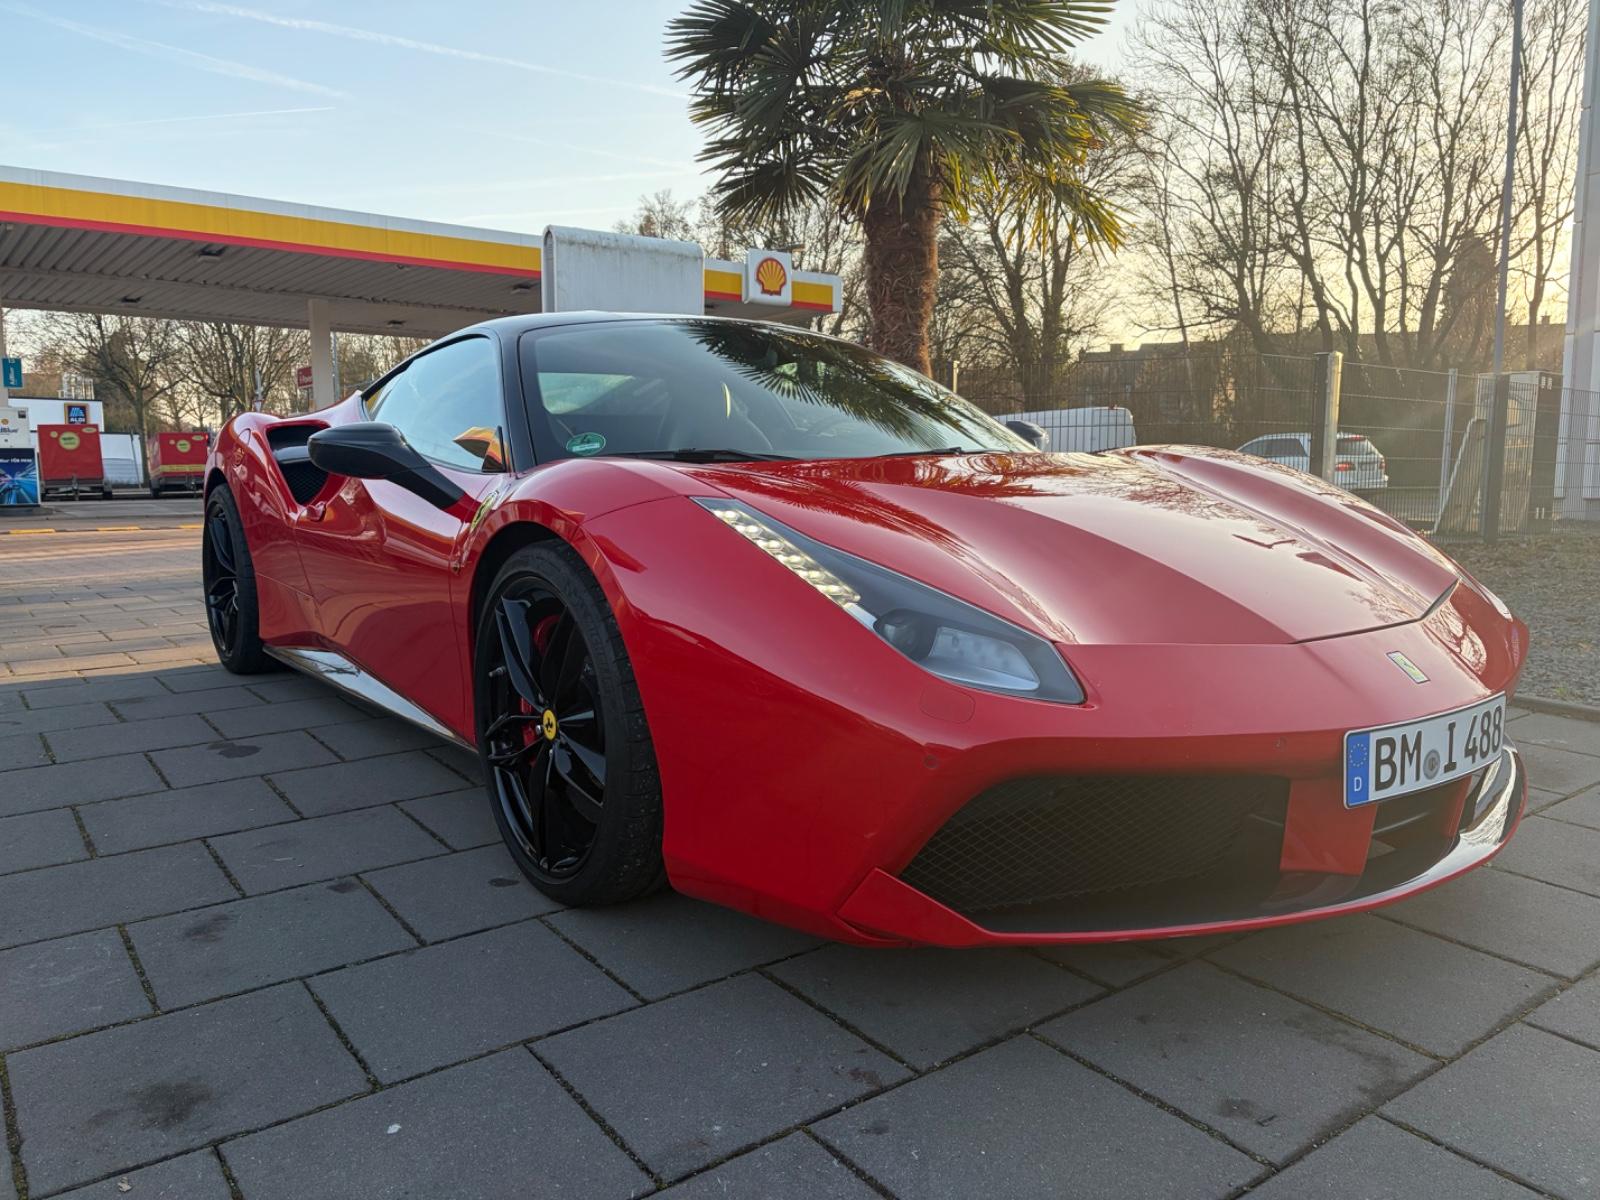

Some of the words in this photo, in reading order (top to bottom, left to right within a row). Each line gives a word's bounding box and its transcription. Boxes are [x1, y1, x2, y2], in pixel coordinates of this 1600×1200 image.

[1374, 730, 1422, 792] BM
[1444, 722, 1456, 773] I
[1464, 705, 1502, 764] 488
[1353, 776, 1362, 792] D
